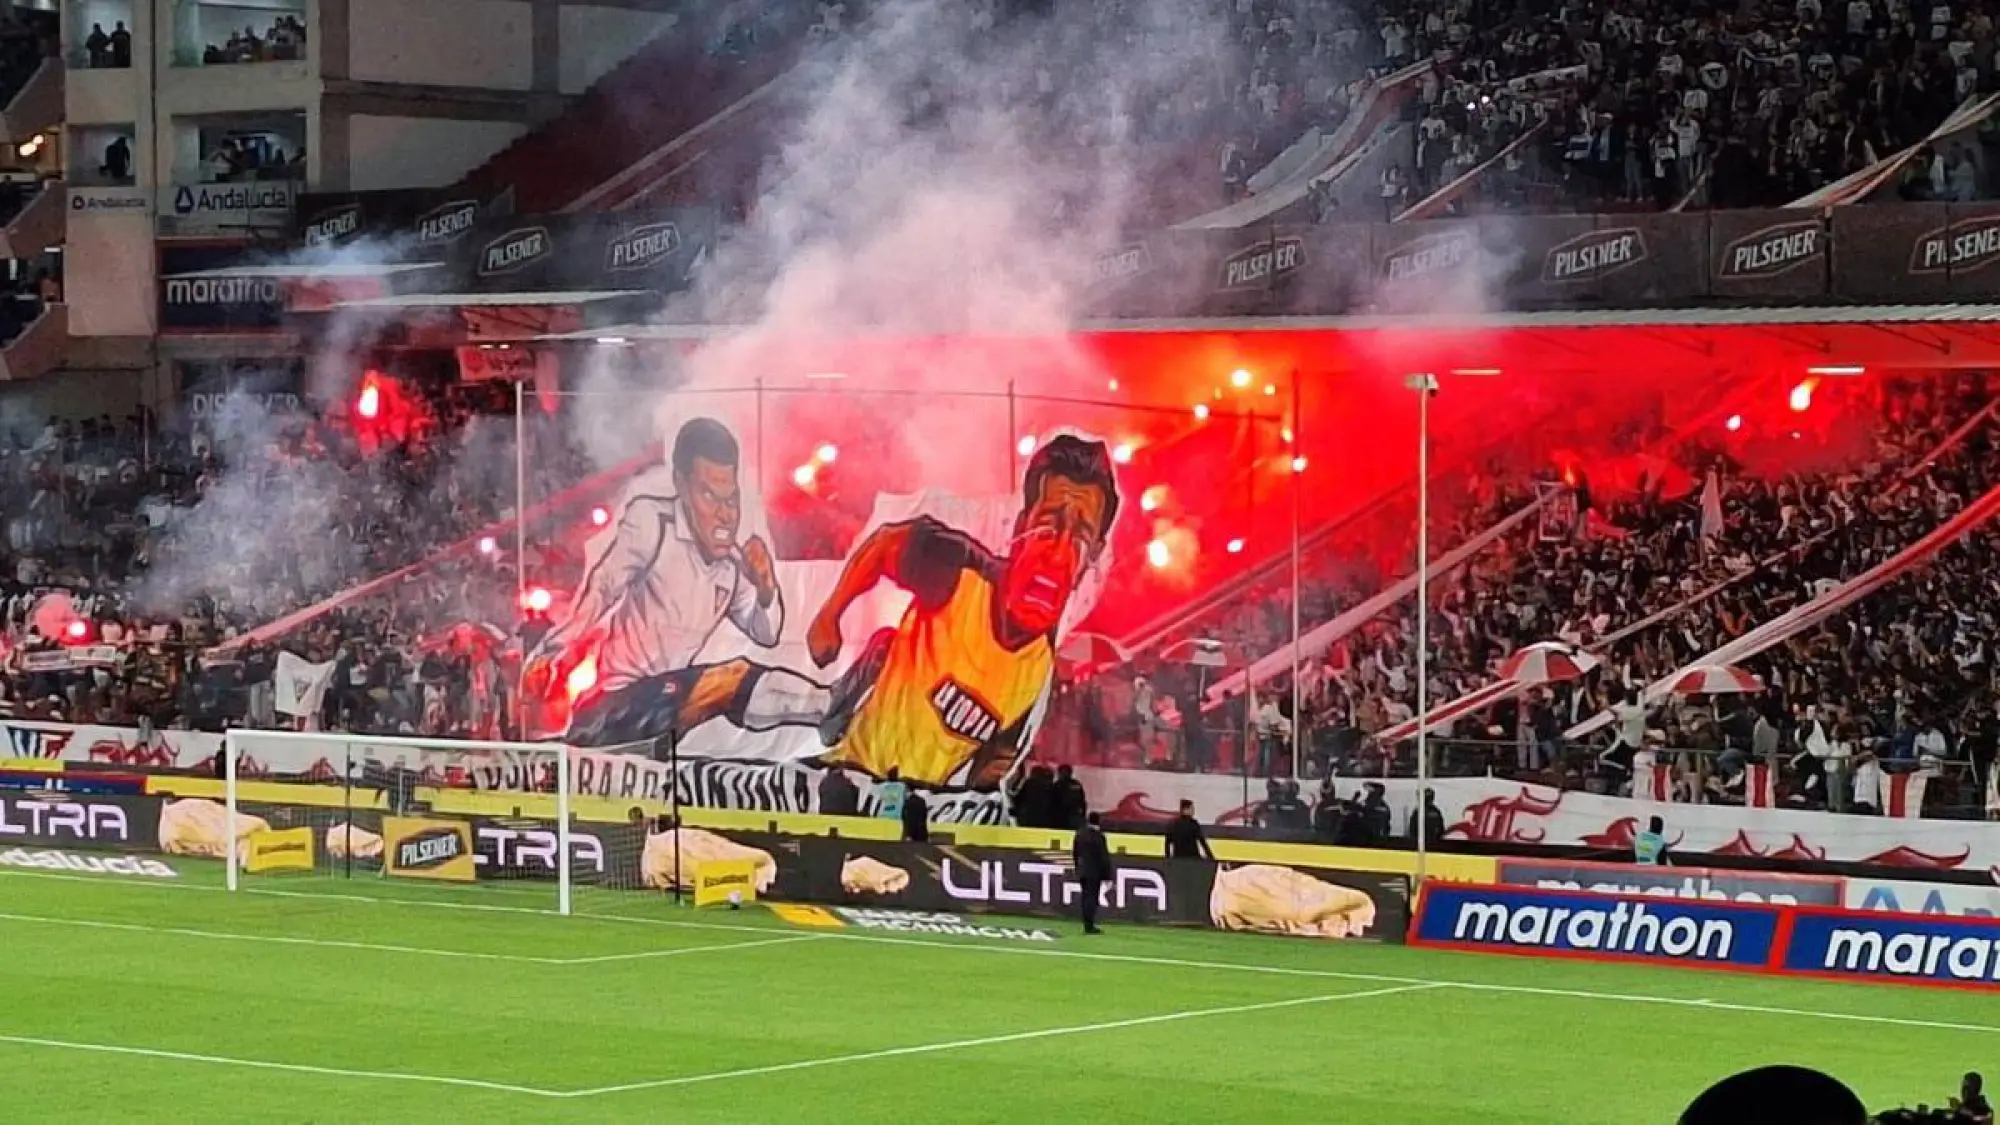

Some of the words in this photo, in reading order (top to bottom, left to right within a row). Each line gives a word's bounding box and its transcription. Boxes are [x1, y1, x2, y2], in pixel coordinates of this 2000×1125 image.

[487, 233, 542, 271] PILSENER
[613, 229, 672, 266] PILSENER
[1733, 228, 1816, 273] PILSENER
[1924, 226, 2000, 268] PILSENE
[401, 833, 458, 867] PILSENER
[1453, 900, 1734, 960] marathon
